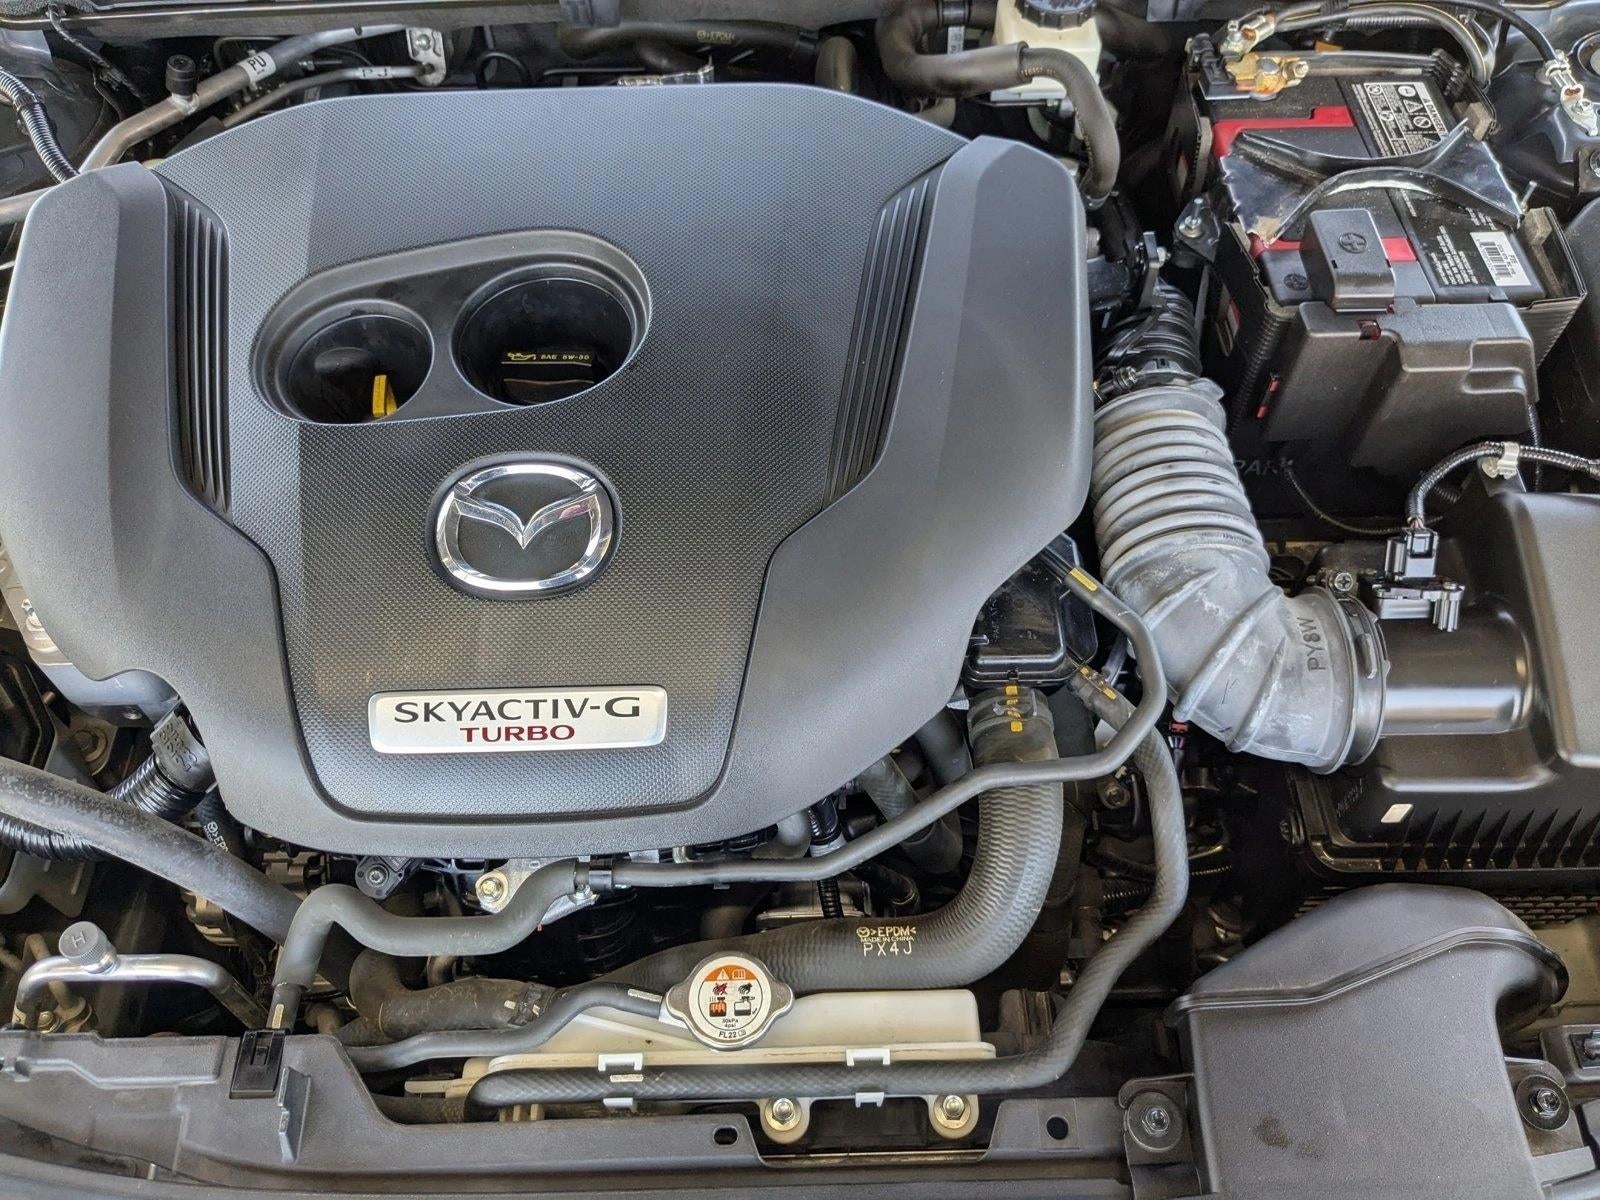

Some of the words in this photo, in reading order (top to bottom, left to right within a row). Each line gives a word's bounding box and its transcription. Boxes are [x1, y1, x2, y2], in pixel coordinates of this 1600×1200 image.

[249, 54, 267, 71] PU
[1427, 104, 1446, 131] DANGER
[1297, 617, 1326, 672] PY8W
[394, 696, 640, 723] SKYACTIV-G
[460, 724, 575, 743] TURBO
[71, 930, 87, 948] H
